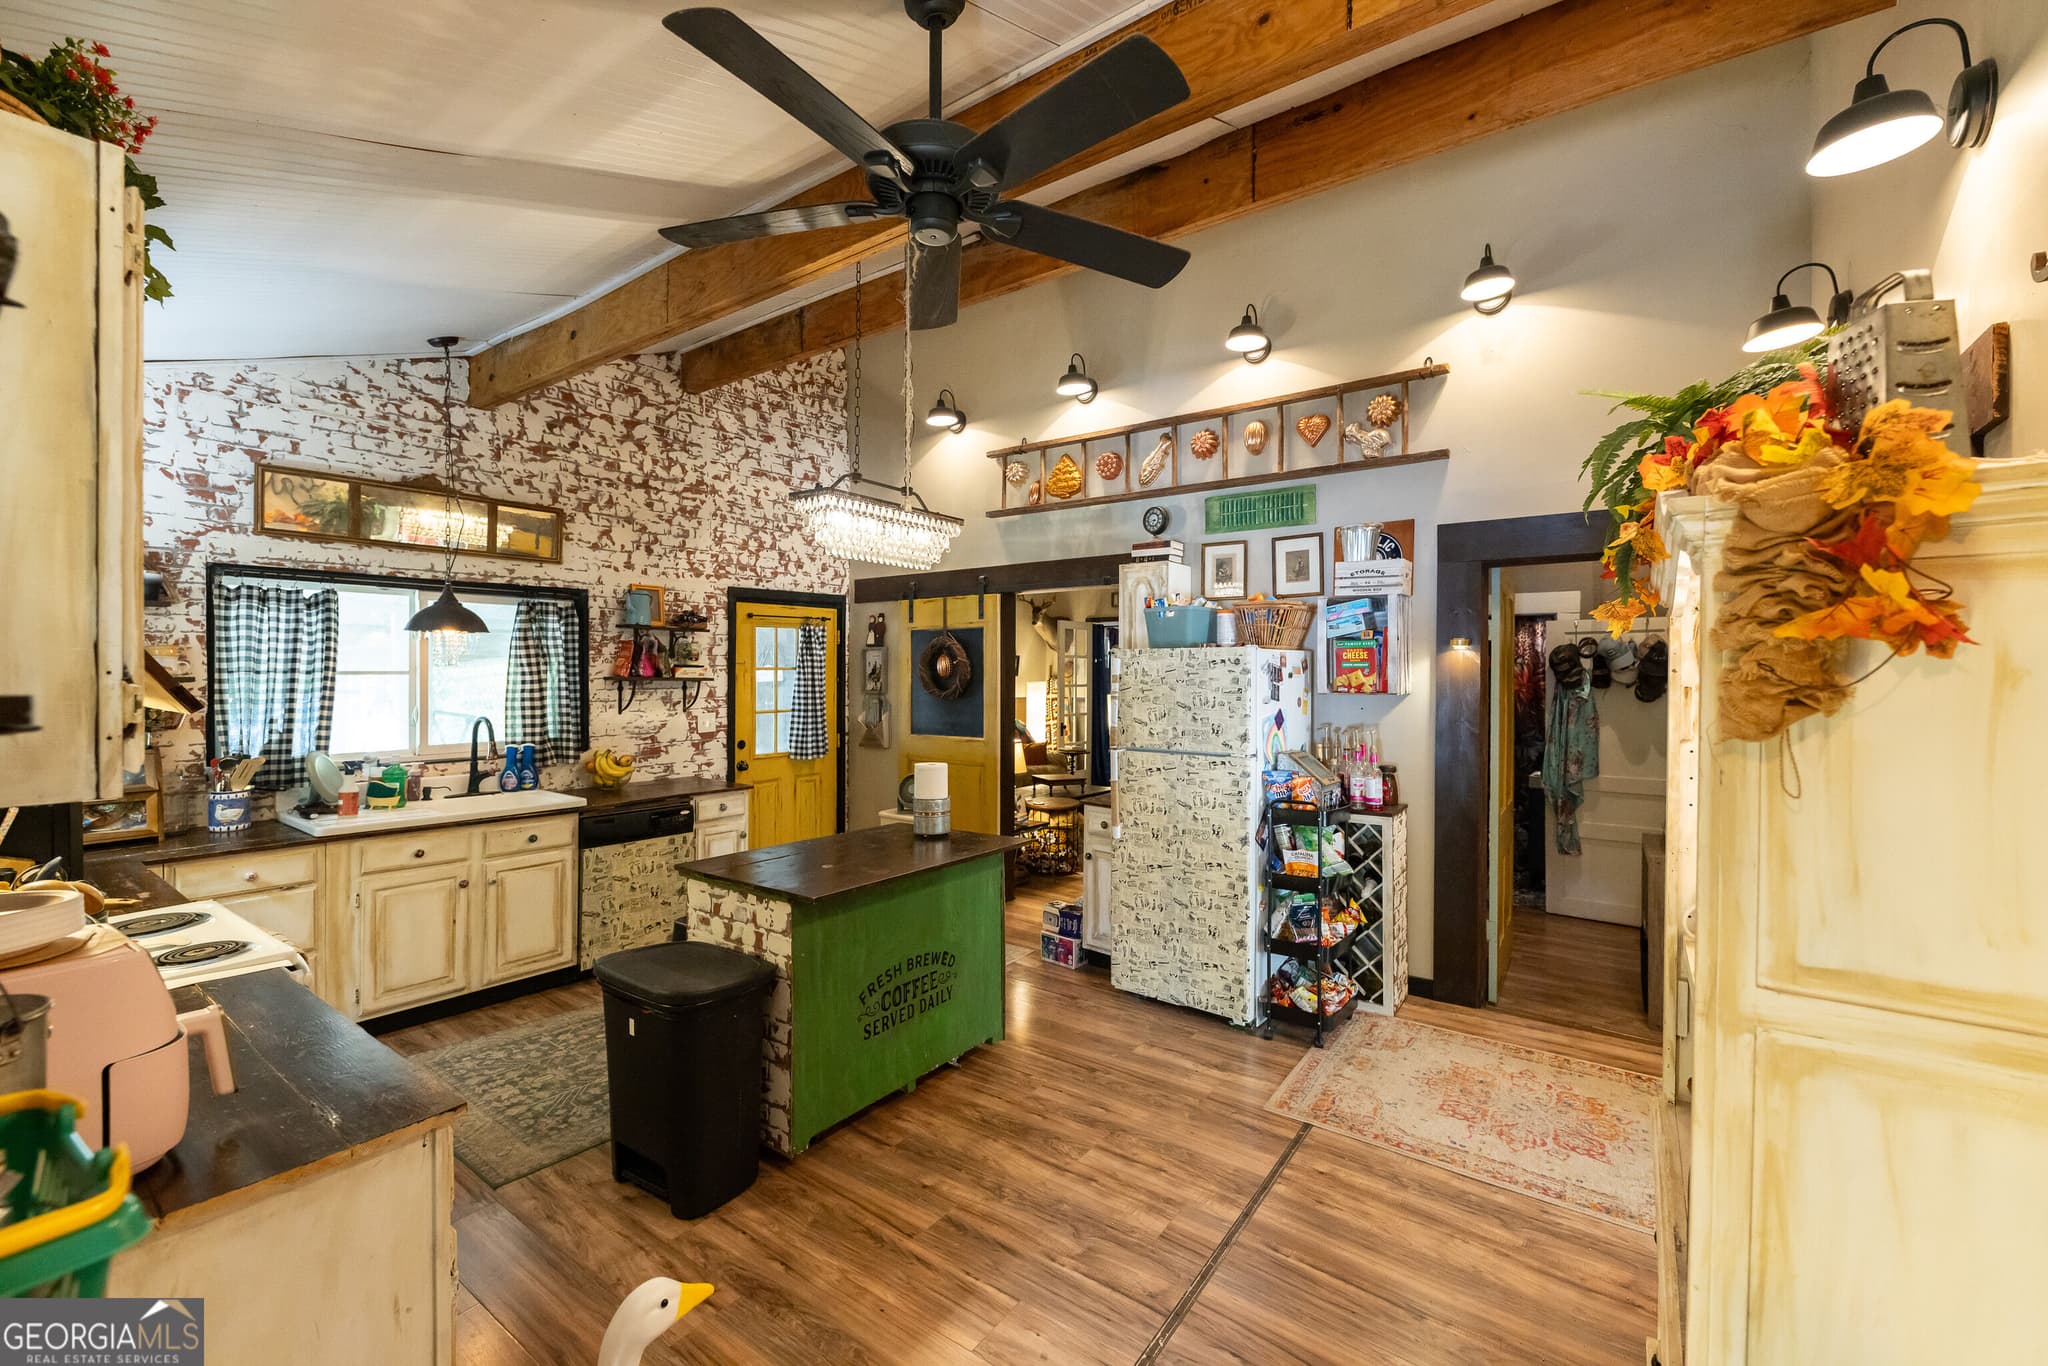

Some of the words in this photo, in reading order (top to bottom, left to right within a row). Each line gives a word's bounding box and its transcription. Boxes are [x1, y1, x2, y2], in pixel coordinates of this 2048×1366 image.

[1350, 568, 1386, 577] STORAGE
[1342, 651, 1369, 660] CHEESE
[858, 962, 903, 1006] FRESH
[906, 950, 956, 972] BREWED
[880, 970, 938, 1012] COFFEE
[863, 1003, 915, 1041] SERVED
[919, 985, 953, 1014] DAILY
